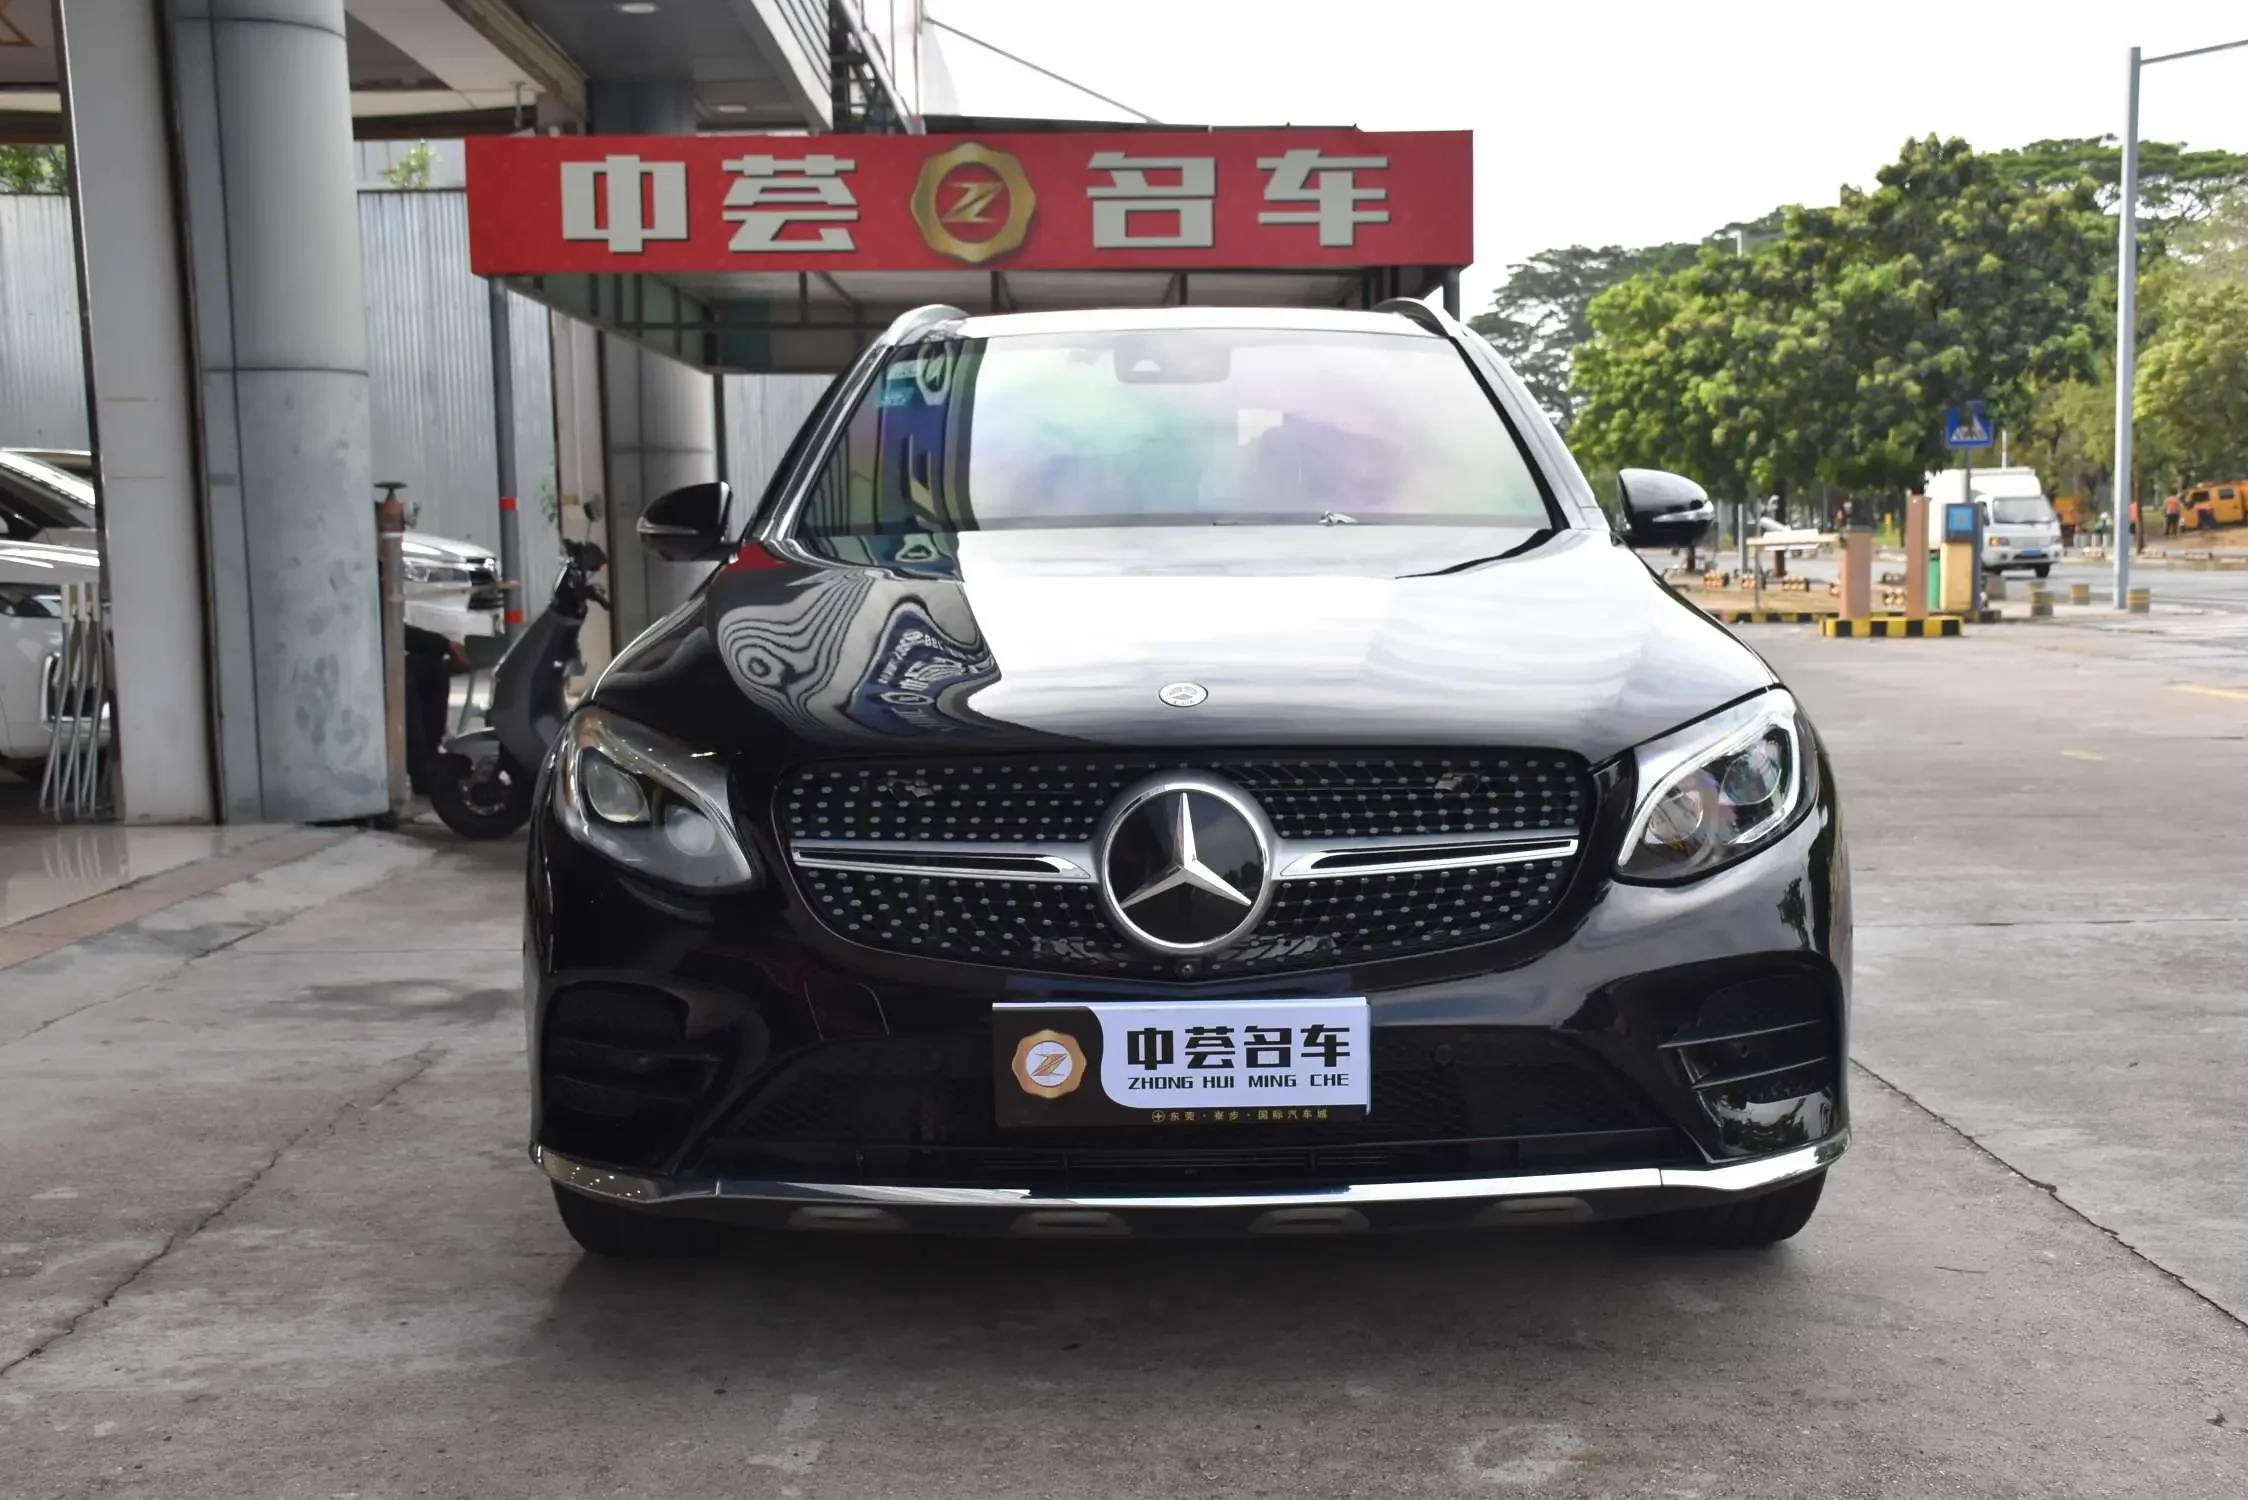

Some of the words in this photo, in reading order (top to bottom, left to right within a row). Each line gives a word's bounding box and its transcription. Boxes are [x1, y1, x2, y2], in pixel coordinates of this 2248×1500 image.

[561, 154, 858, 252] 中荟
[1087, 149, 1390, 247] 名车
[1127, 1024, 1350, 1070] 中荟名车
[1128, 1076, 1193, 1090] ZHONG
[1203, 1075, 1235, 1089] HUI
[1248, 1074, 1297, 1088] MING
[1310, 1073, 1349, 1087] CHE
